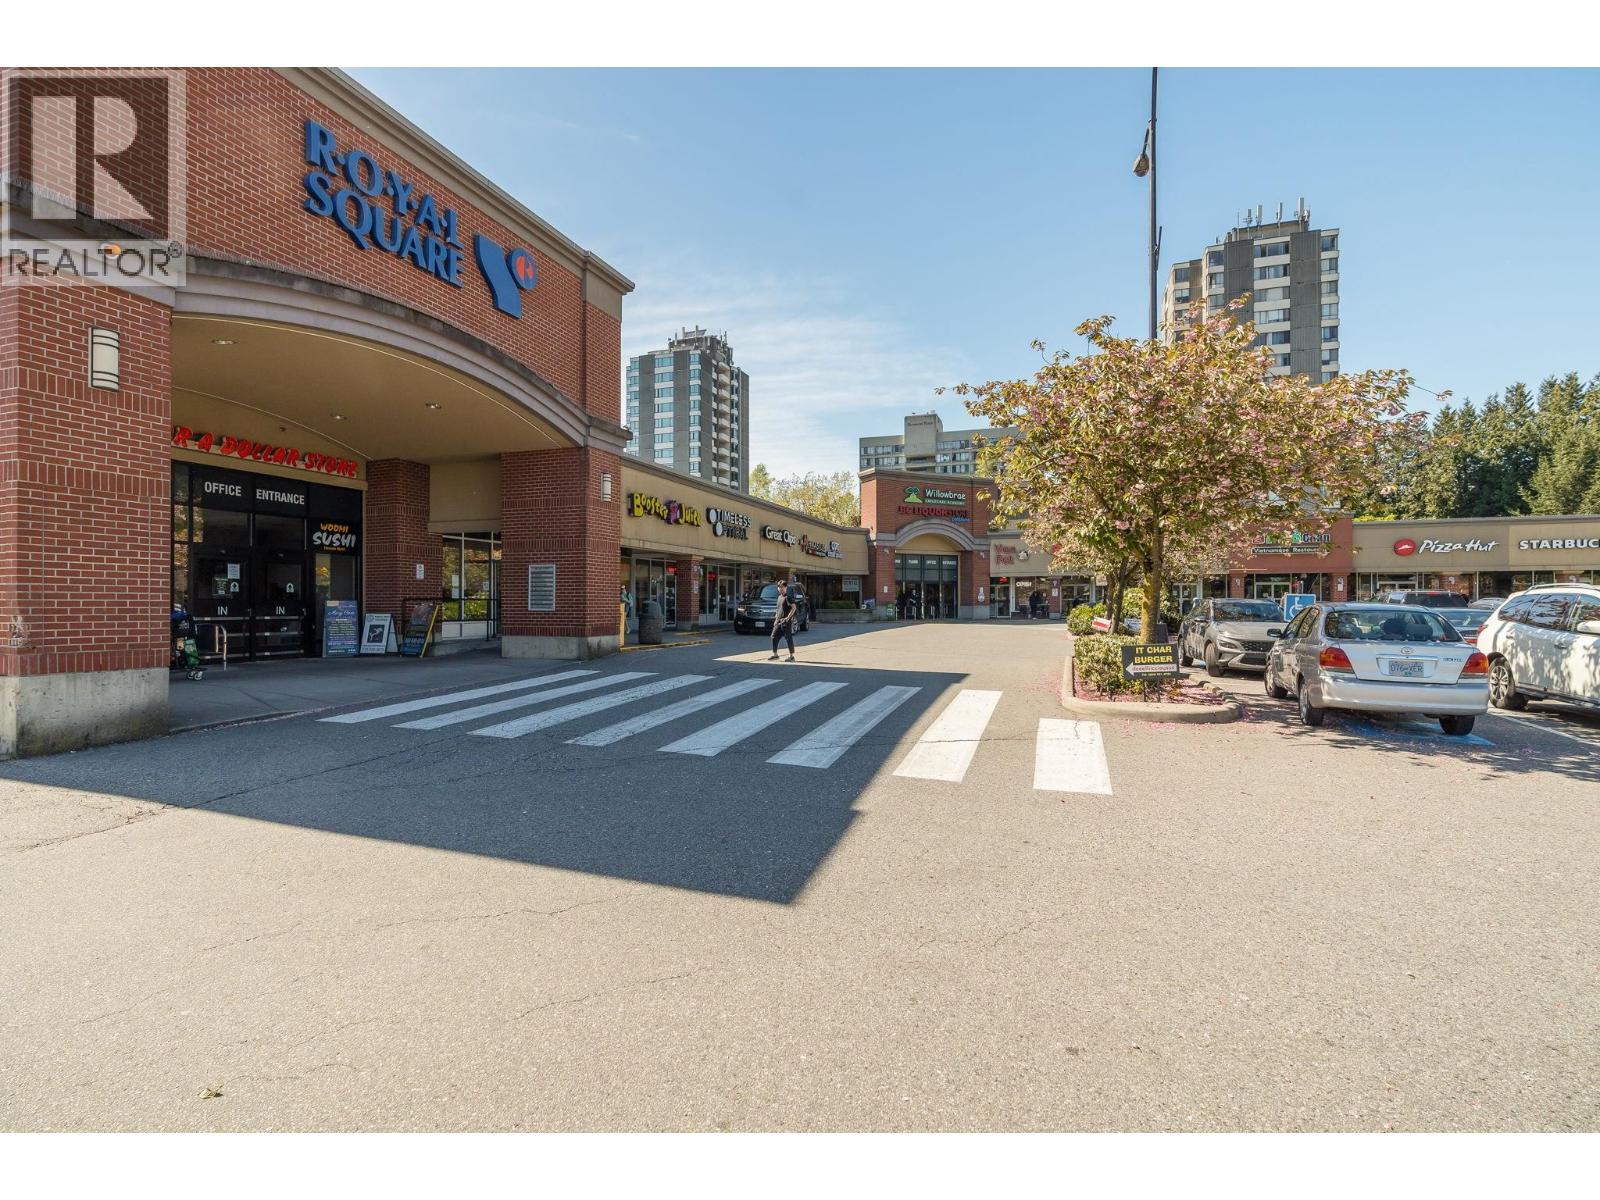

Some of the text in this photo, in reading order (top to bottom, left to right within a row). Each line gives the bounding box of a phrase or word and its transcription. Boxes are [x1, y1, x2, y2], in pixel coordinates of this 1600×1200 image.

[305, 170, 464, 288] SQUARE
[195, 431, 215, 452] A
[219, 435, 300, 467] DOLLAR
[304, 452, 359, 478] STORE
[204, 481, 305, 505] OFFICE ENTRANCE
[925, 488, 966, 500] Willowbrae
[631, 492, 702, 527] Booster Juice
[716, 508, 752, 527] TIMELESS
[312, 531, 357, 548] SUSHI
[764, 526, 782, 541] Great
[1418, 538, 1499, 554] Pizza Hut
[217, 606, 228, 616] IN
[275, 606, 286, 615] IN
[1146, 645, 1172, 653] CHAR
[1134, 655, 1173, 664] BURGER
